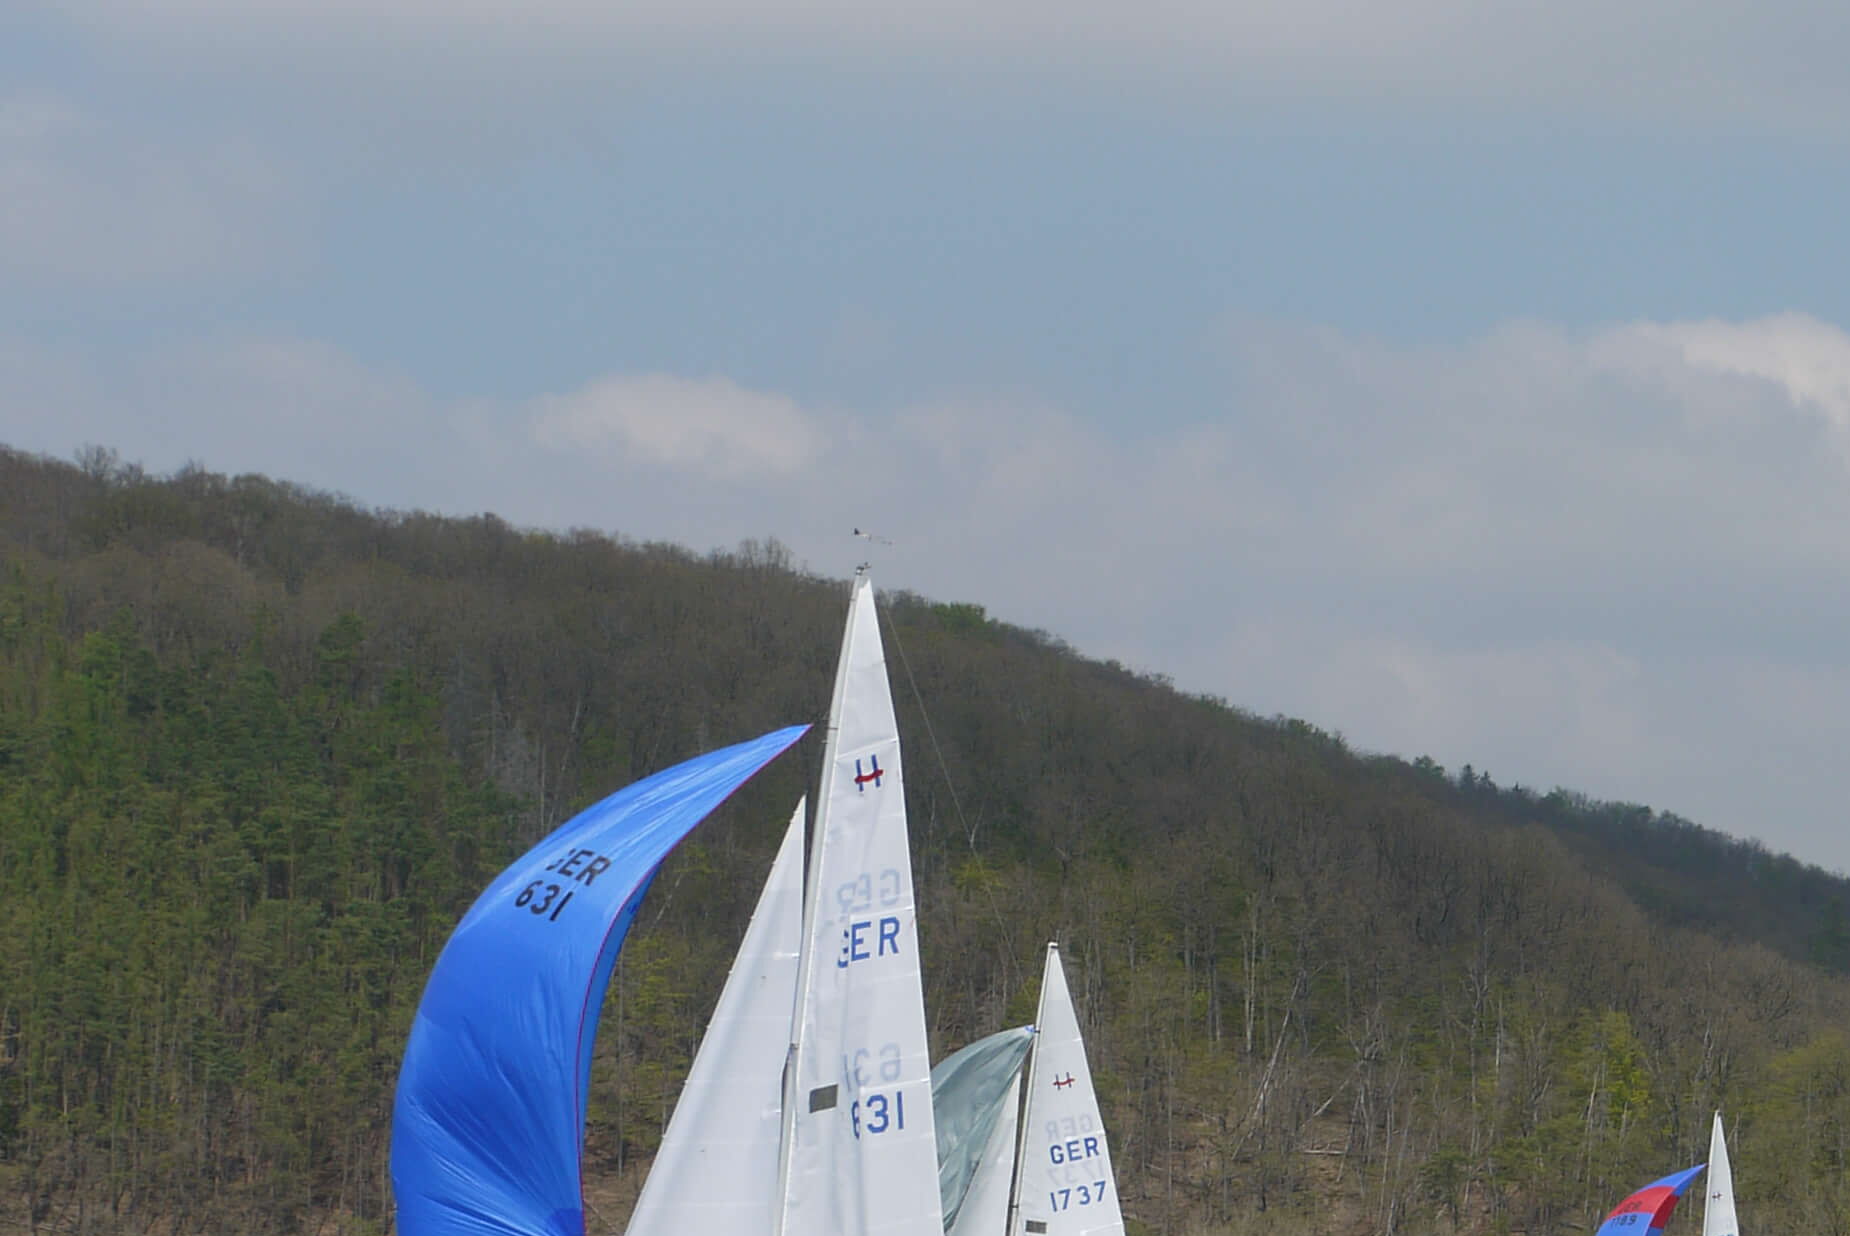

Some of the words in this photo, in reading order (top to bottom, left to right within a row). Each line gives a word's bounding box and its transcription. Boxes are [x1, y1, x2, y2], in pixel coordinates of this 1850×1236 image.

[515, 880, 573, 922] 631
[1050, 1137, 1100, 1164] GER
[1050, 1180, 1106, 1212] 1737
